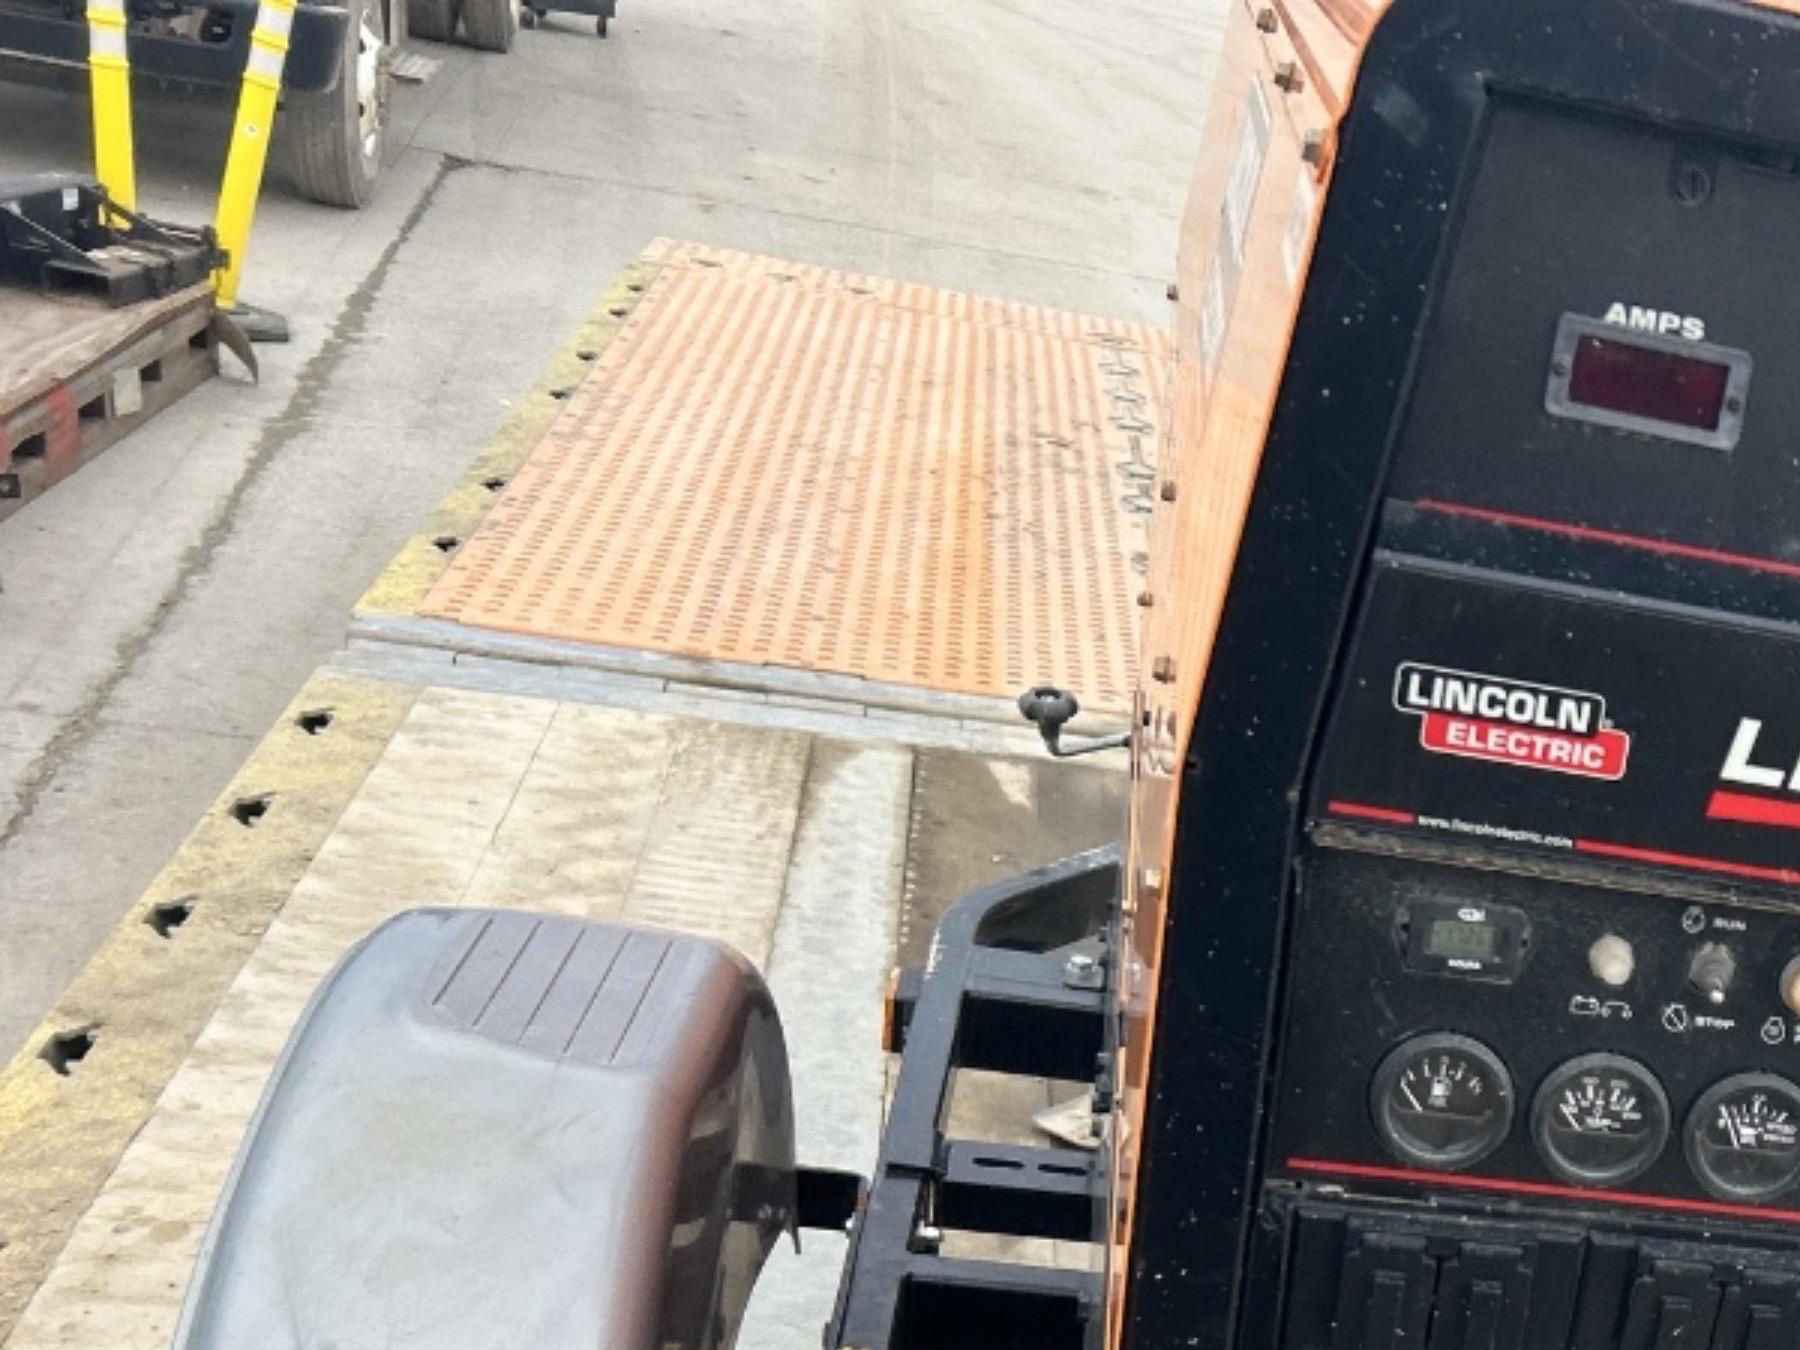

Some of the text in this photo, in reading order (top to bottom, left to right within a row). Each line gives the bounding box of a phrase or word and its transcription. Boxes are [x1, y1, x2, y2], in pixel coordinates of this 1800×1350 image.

[1604, 302, 1705, 341] AMPS
[1405, 672, 1592, 734] LINCOLN
[1444, 720, 1607, 771] ELECTRIC
[1693, 1015, 1736, 1030] STOP
